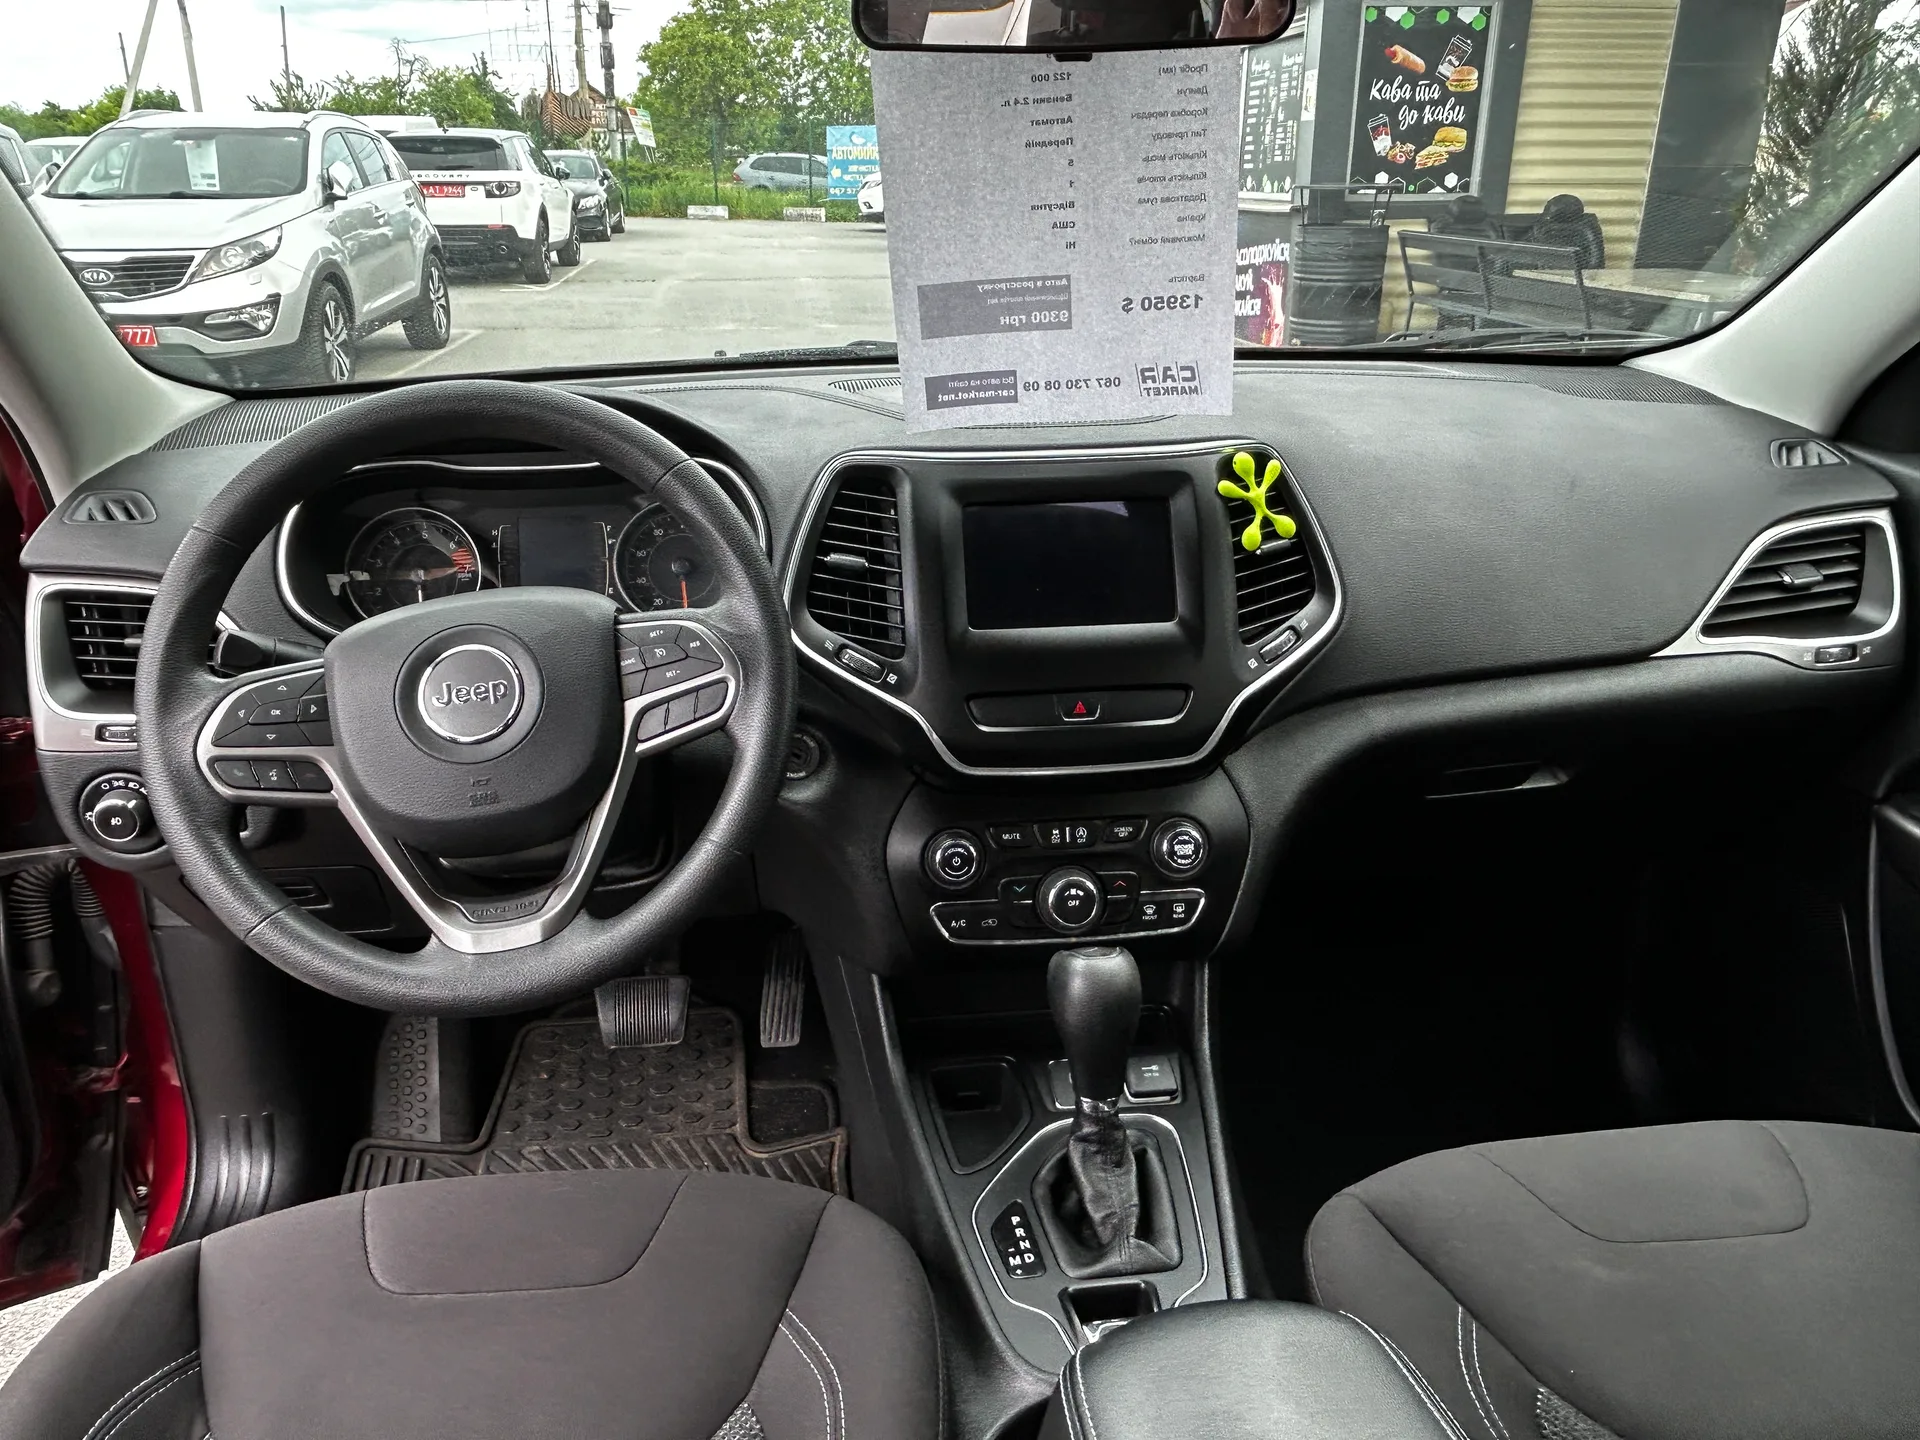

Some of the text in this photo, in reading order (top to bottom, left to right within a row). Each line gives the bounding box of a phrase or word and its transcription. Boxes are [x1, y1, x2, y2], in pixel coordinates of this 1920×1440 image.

[1369, 75, 1441, 103] Кава та
[1398, 97, 1466, 130] до кави
[832, 143, 880, 160] АВТОМИЙК
[84, 272, 108, 282] KIA
[431, 680, 508, 707] Jeep
[951, 919, 966, 928] A/C
[1010, 1215, 1021, 1226] P
[1014, 1227, 1026, 1237] R
[1019, 1239, 1031, 1250] N
[1008, 1252, 1035, 1266] M D
